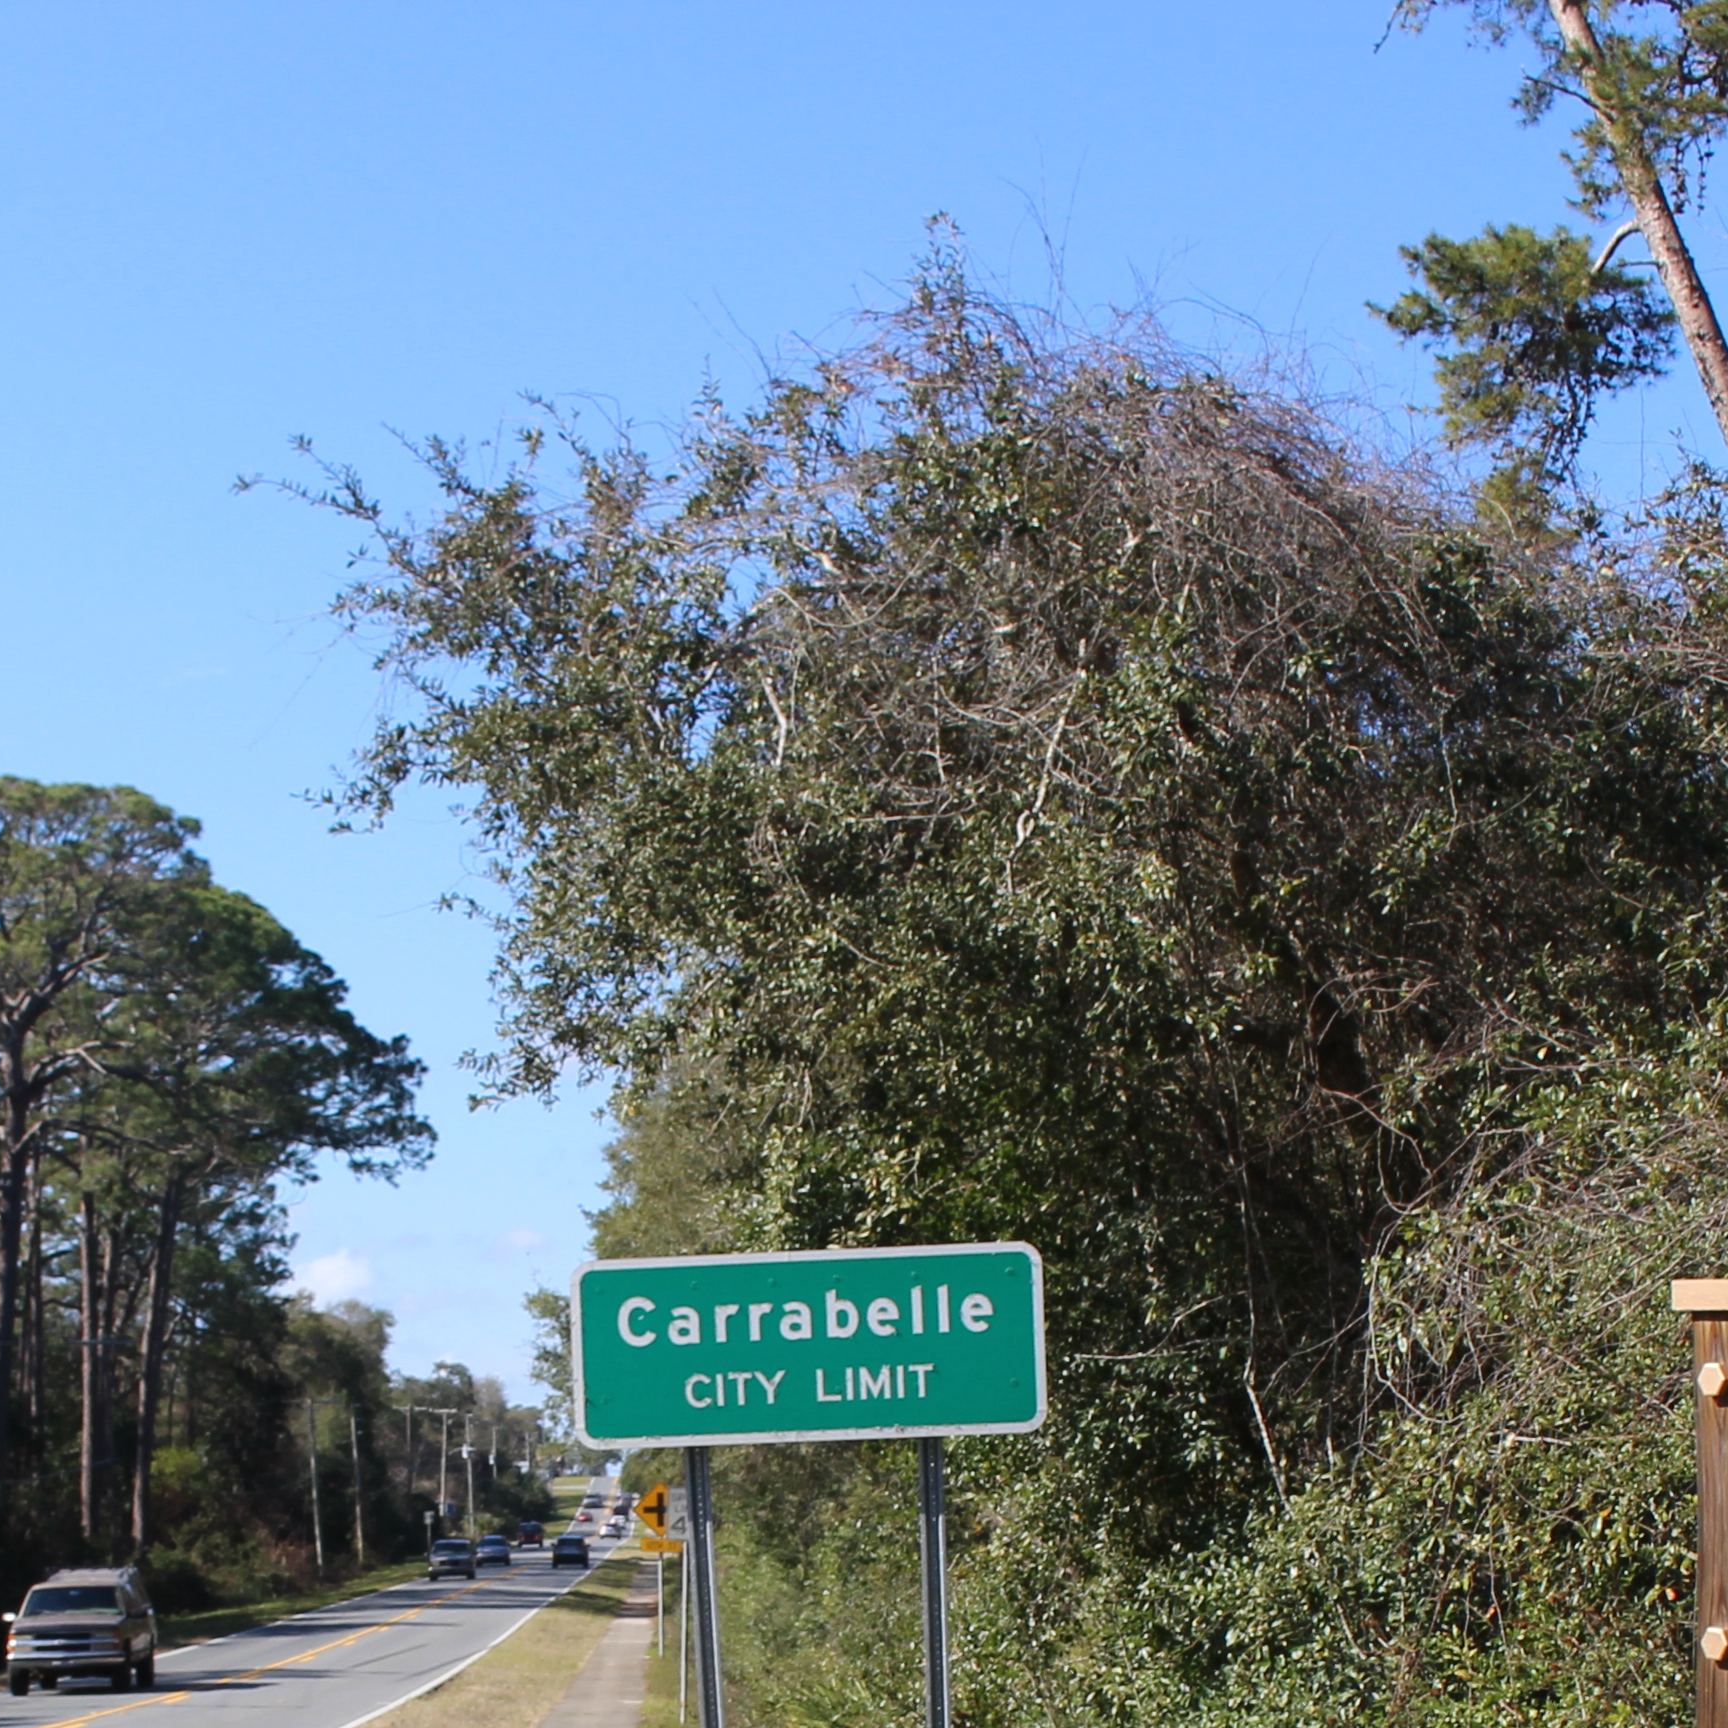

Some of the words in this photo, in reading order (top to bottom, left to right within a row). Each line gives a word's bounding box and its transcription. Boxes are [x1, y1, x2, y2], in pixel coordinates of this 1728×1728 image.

[616, 1284, 994, 1348] Carrabelle
[684, 1370, 787, 1408] CITY
[815, 1363, 935, 1403] LIMIT
